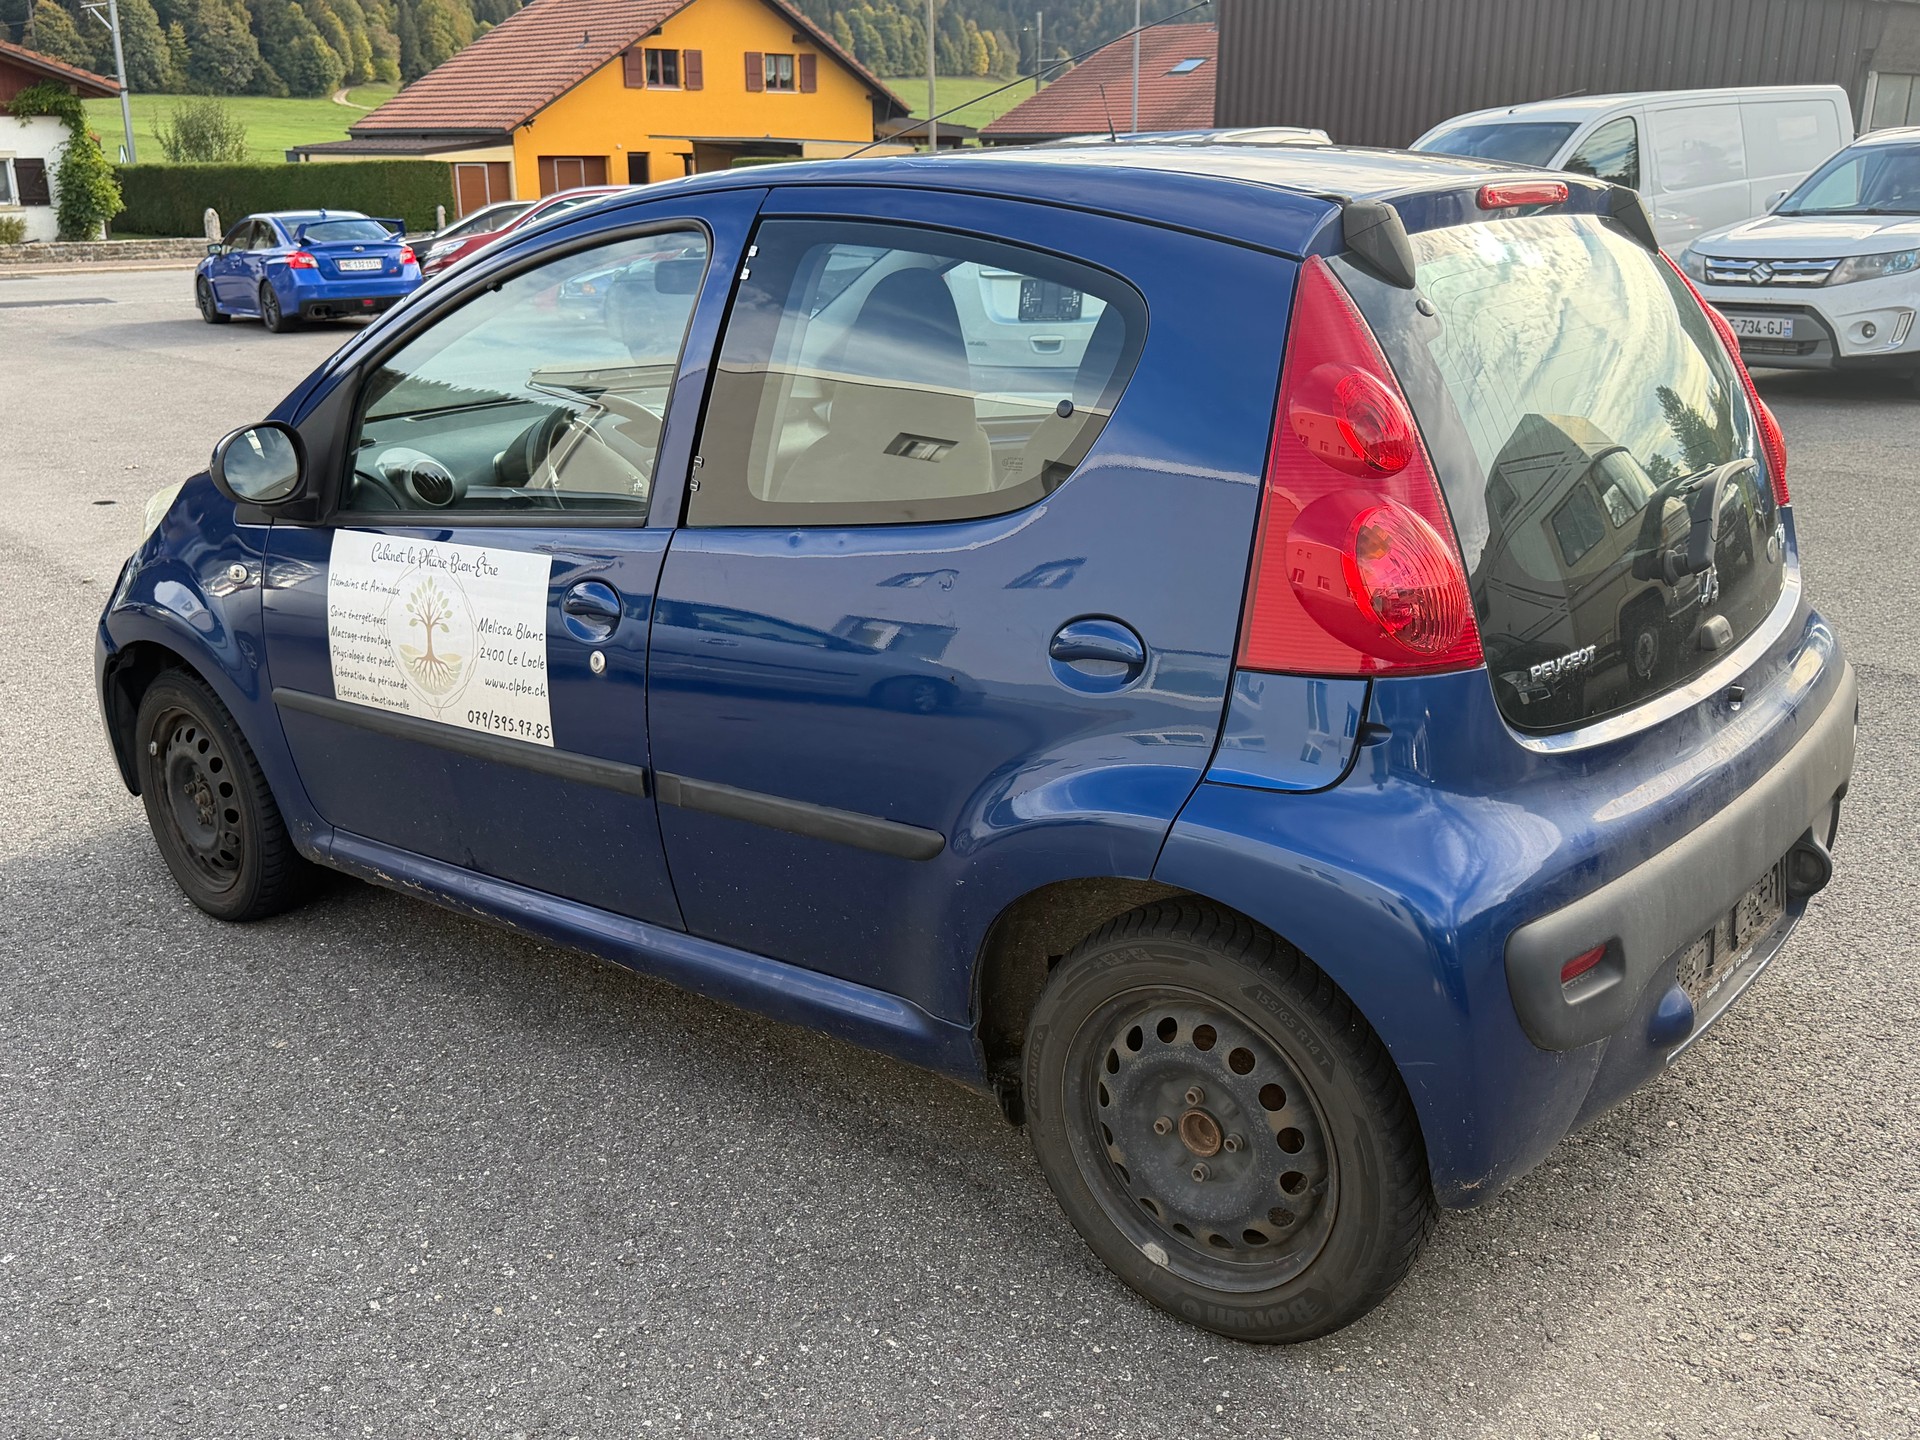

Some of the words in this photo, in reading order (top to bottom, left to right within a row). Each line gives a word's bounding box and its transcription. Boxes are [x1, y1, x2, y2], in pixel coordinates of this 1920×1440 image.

[371, 542, 407, 562] Cabinet
[407, 546, 416, 565] le
[418, 548, 447, 569] Phare
[450, 551, 499, 577] Bien-Être
[330, 572, 359, 590] Humains
[361, 580, 368, 591] et
[369, 579, 400, 596] Animaux
[330, 604, 347, 619] Soins
[348, 609, 387, 627] énergétiques
[330, 625, 391, 649] Massage-reboutage
[477, 617, 513, 637] Melissa
[515, 622, 544, 642] Blanc
[332, 644, 365, 664] Physiologie
[366, 652, 378, 665] des
[378, 656, 395, 668] pieds
[480, 647, 504, 662] 2400
[507, 649, 518, 666] Le
[521, 651, 545, 670] Locle
[1530, 644, 1596, 682] PEUGEOT
[334, 665, 367, 681] Libération
[368, 672, 377, 684] du
[377, 675, 408, 691] péricarde
[484, 678, 547, 698] www.clpbe.ch
[337, 684, 369, 701] Libération
[370, 692, 410, 710] émotionnelle
[467, 709, 550, 740] 079/395.97.85
[1256, 989, 1297, 1028] 155/65
[1297, 1028, 1320, 1055] R14
[1320, 1055, 1331, 1067] T
[1029, 1042, 1041, 1109] POLARIS
[1207, 1297, 1321, 1328] Barum
